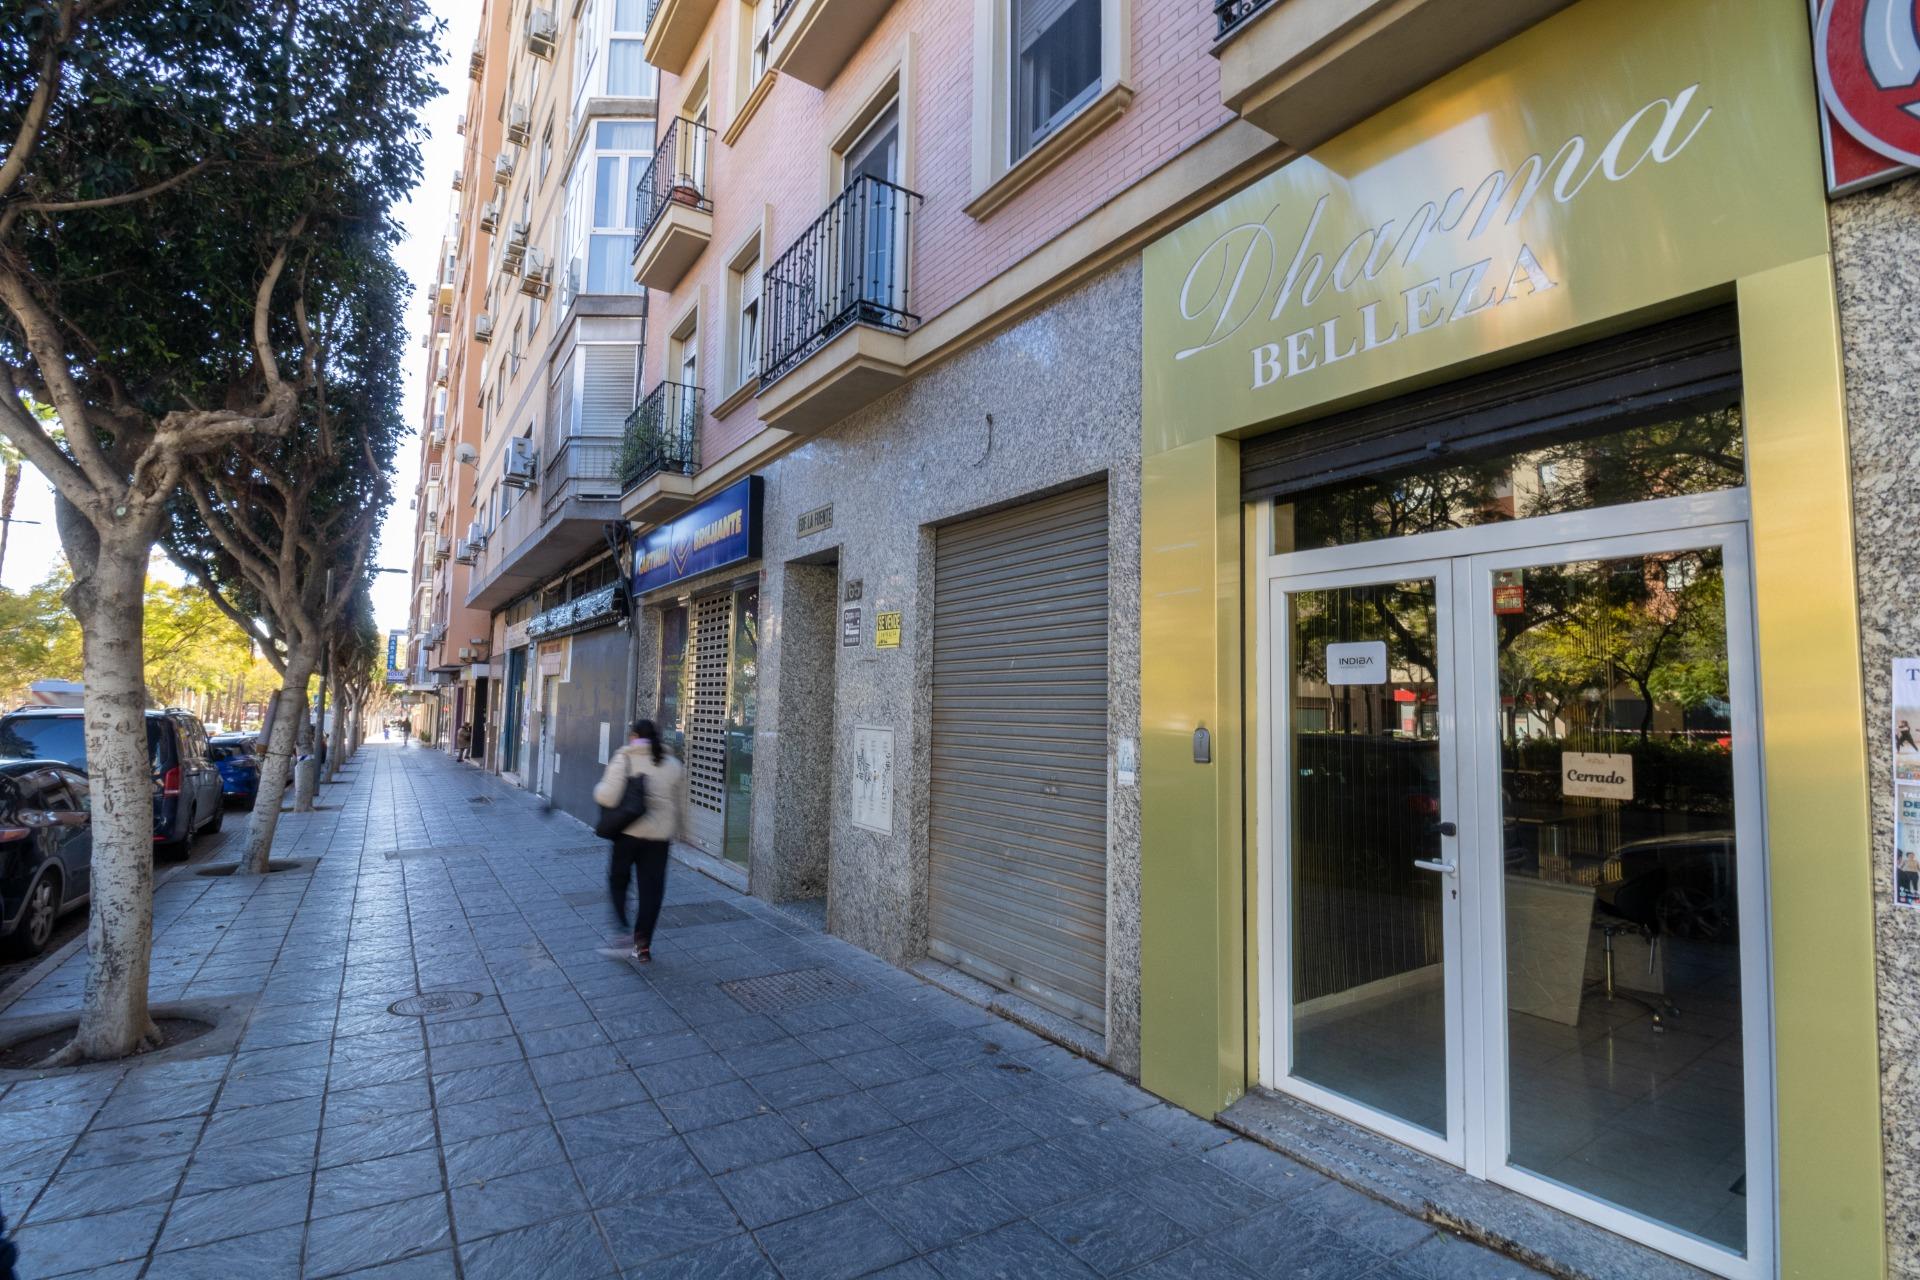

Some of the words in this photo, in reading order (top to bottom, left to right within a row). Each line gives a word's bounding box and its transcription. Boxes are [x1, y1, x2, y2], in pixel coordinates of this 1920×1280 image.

[1174, 82, 1713, 360] Dharma
[1248, 243, 1558, 391] BELLEZA
[814, 506, 832, 526] FUENTE
[878, 616, 885, 630] SE
[885, 614, 900, 629] VENDE
[1339, 656, 1374, 665] INDIBA
[1567, 769, 1626, 784] Cerrado
